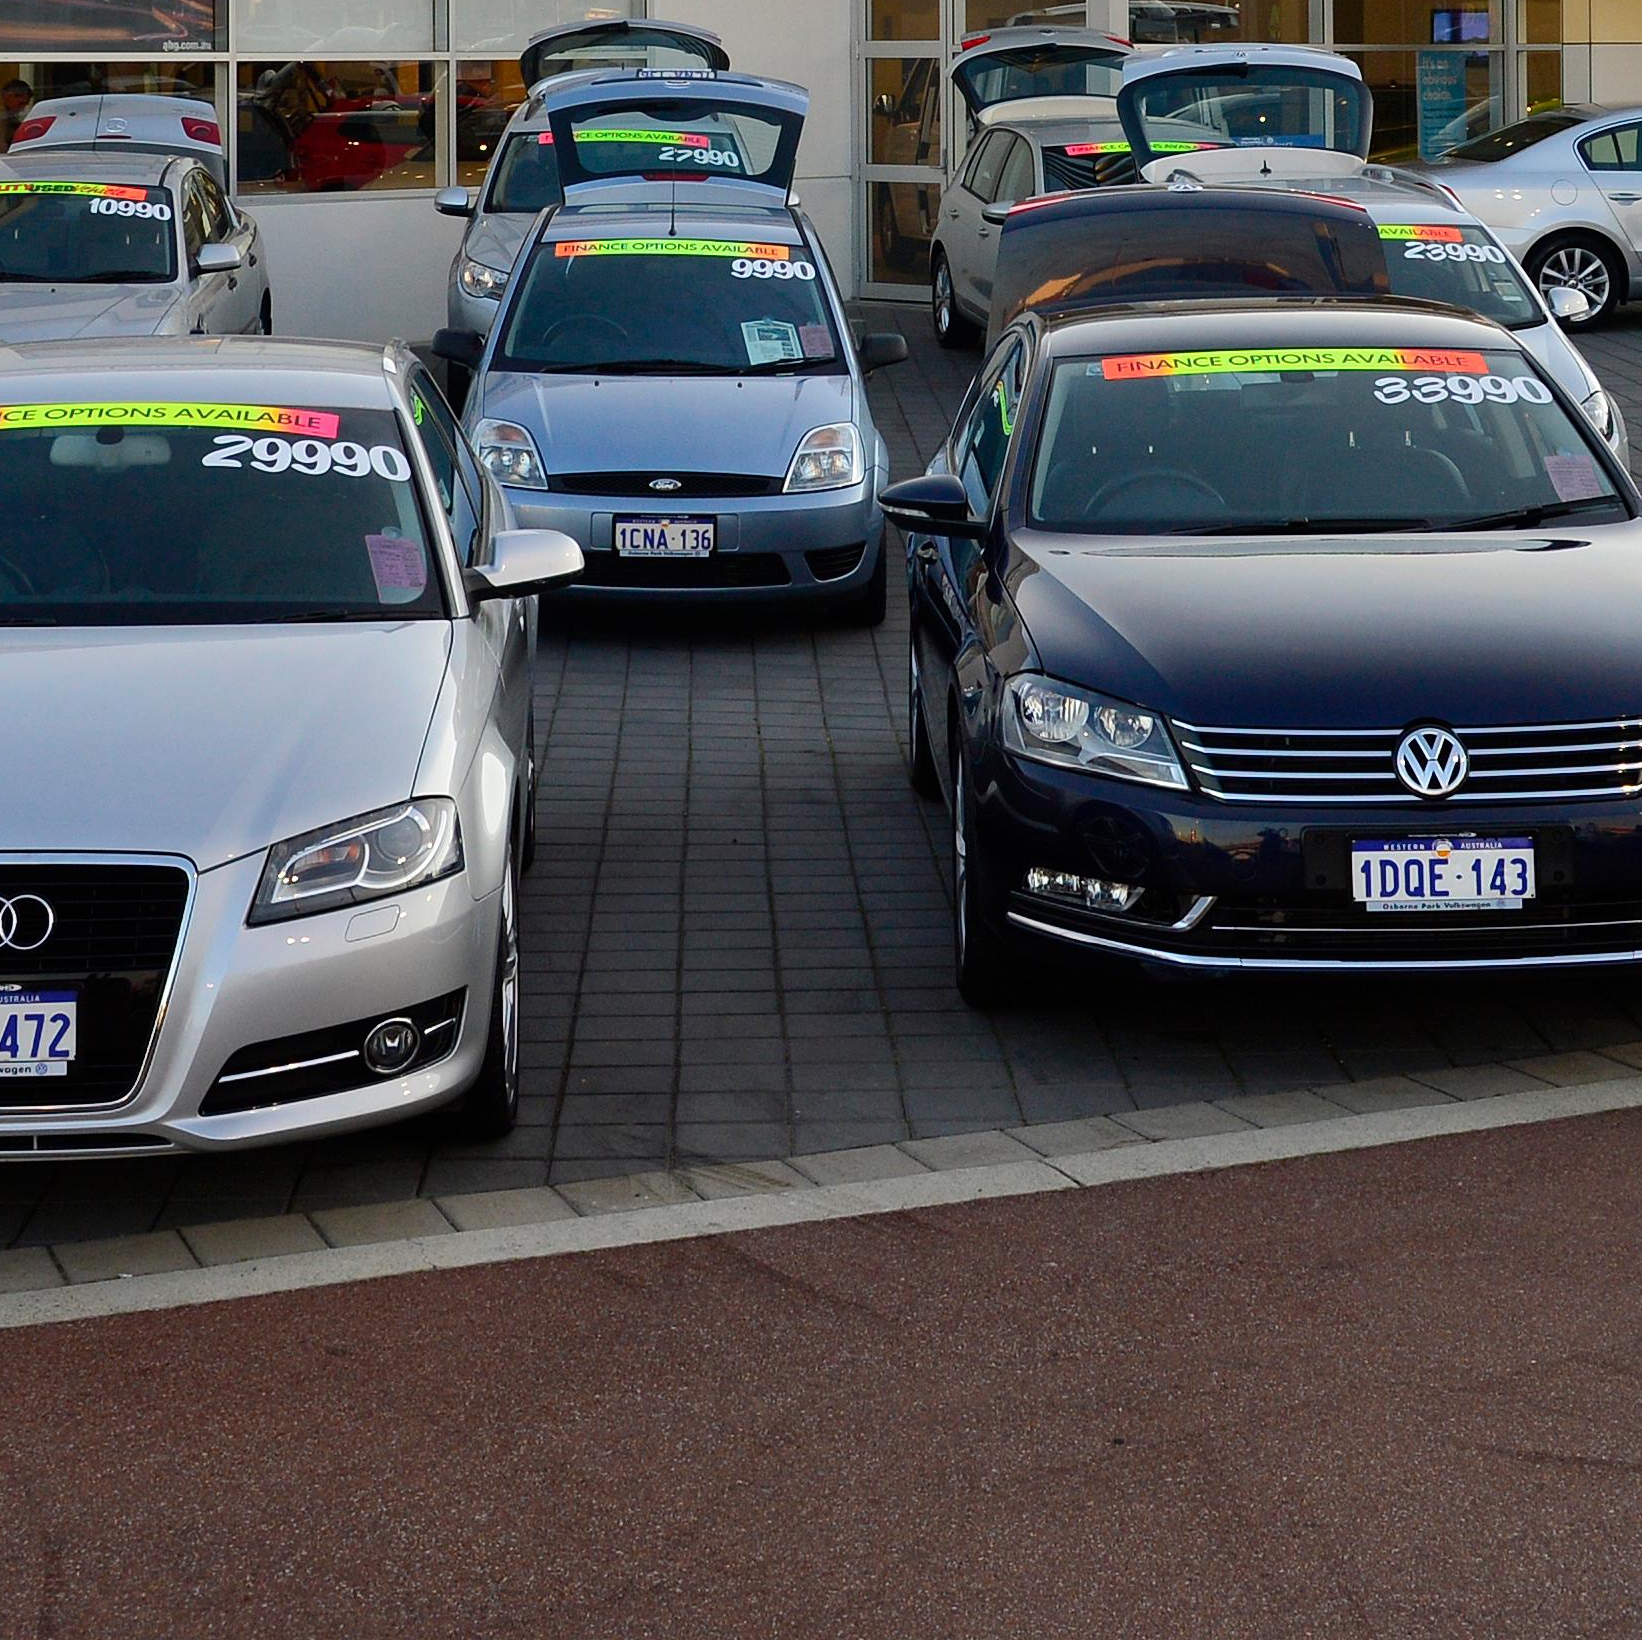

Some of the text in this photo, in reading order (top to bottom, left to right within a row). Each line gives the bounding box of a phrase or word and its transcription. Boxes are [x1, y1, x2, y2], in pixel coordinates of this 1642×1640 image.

[595, 131, 643, 140] OPTIONS
[658, 146, 739, 168] 27990
[88, 197, 172, 221] 10990
[563, 242, 779, 257] FINANCE OPTIONS AVAILABLE
[1403, 241, 1506, 264] 23990
[731, 258, 816, 281] 9990
[1116, 351, 1468, 373] FINANCE OPTIONS AVAILABLE
[1373, 376, 1554, 404] 33990
[43, 406, 167, 421] OPTIONS
[173, 407, 323, 430] AVAILABLE
[201, 434, 412, 482] 29990
[1443, 901, 1491, 910] Volkswagen
